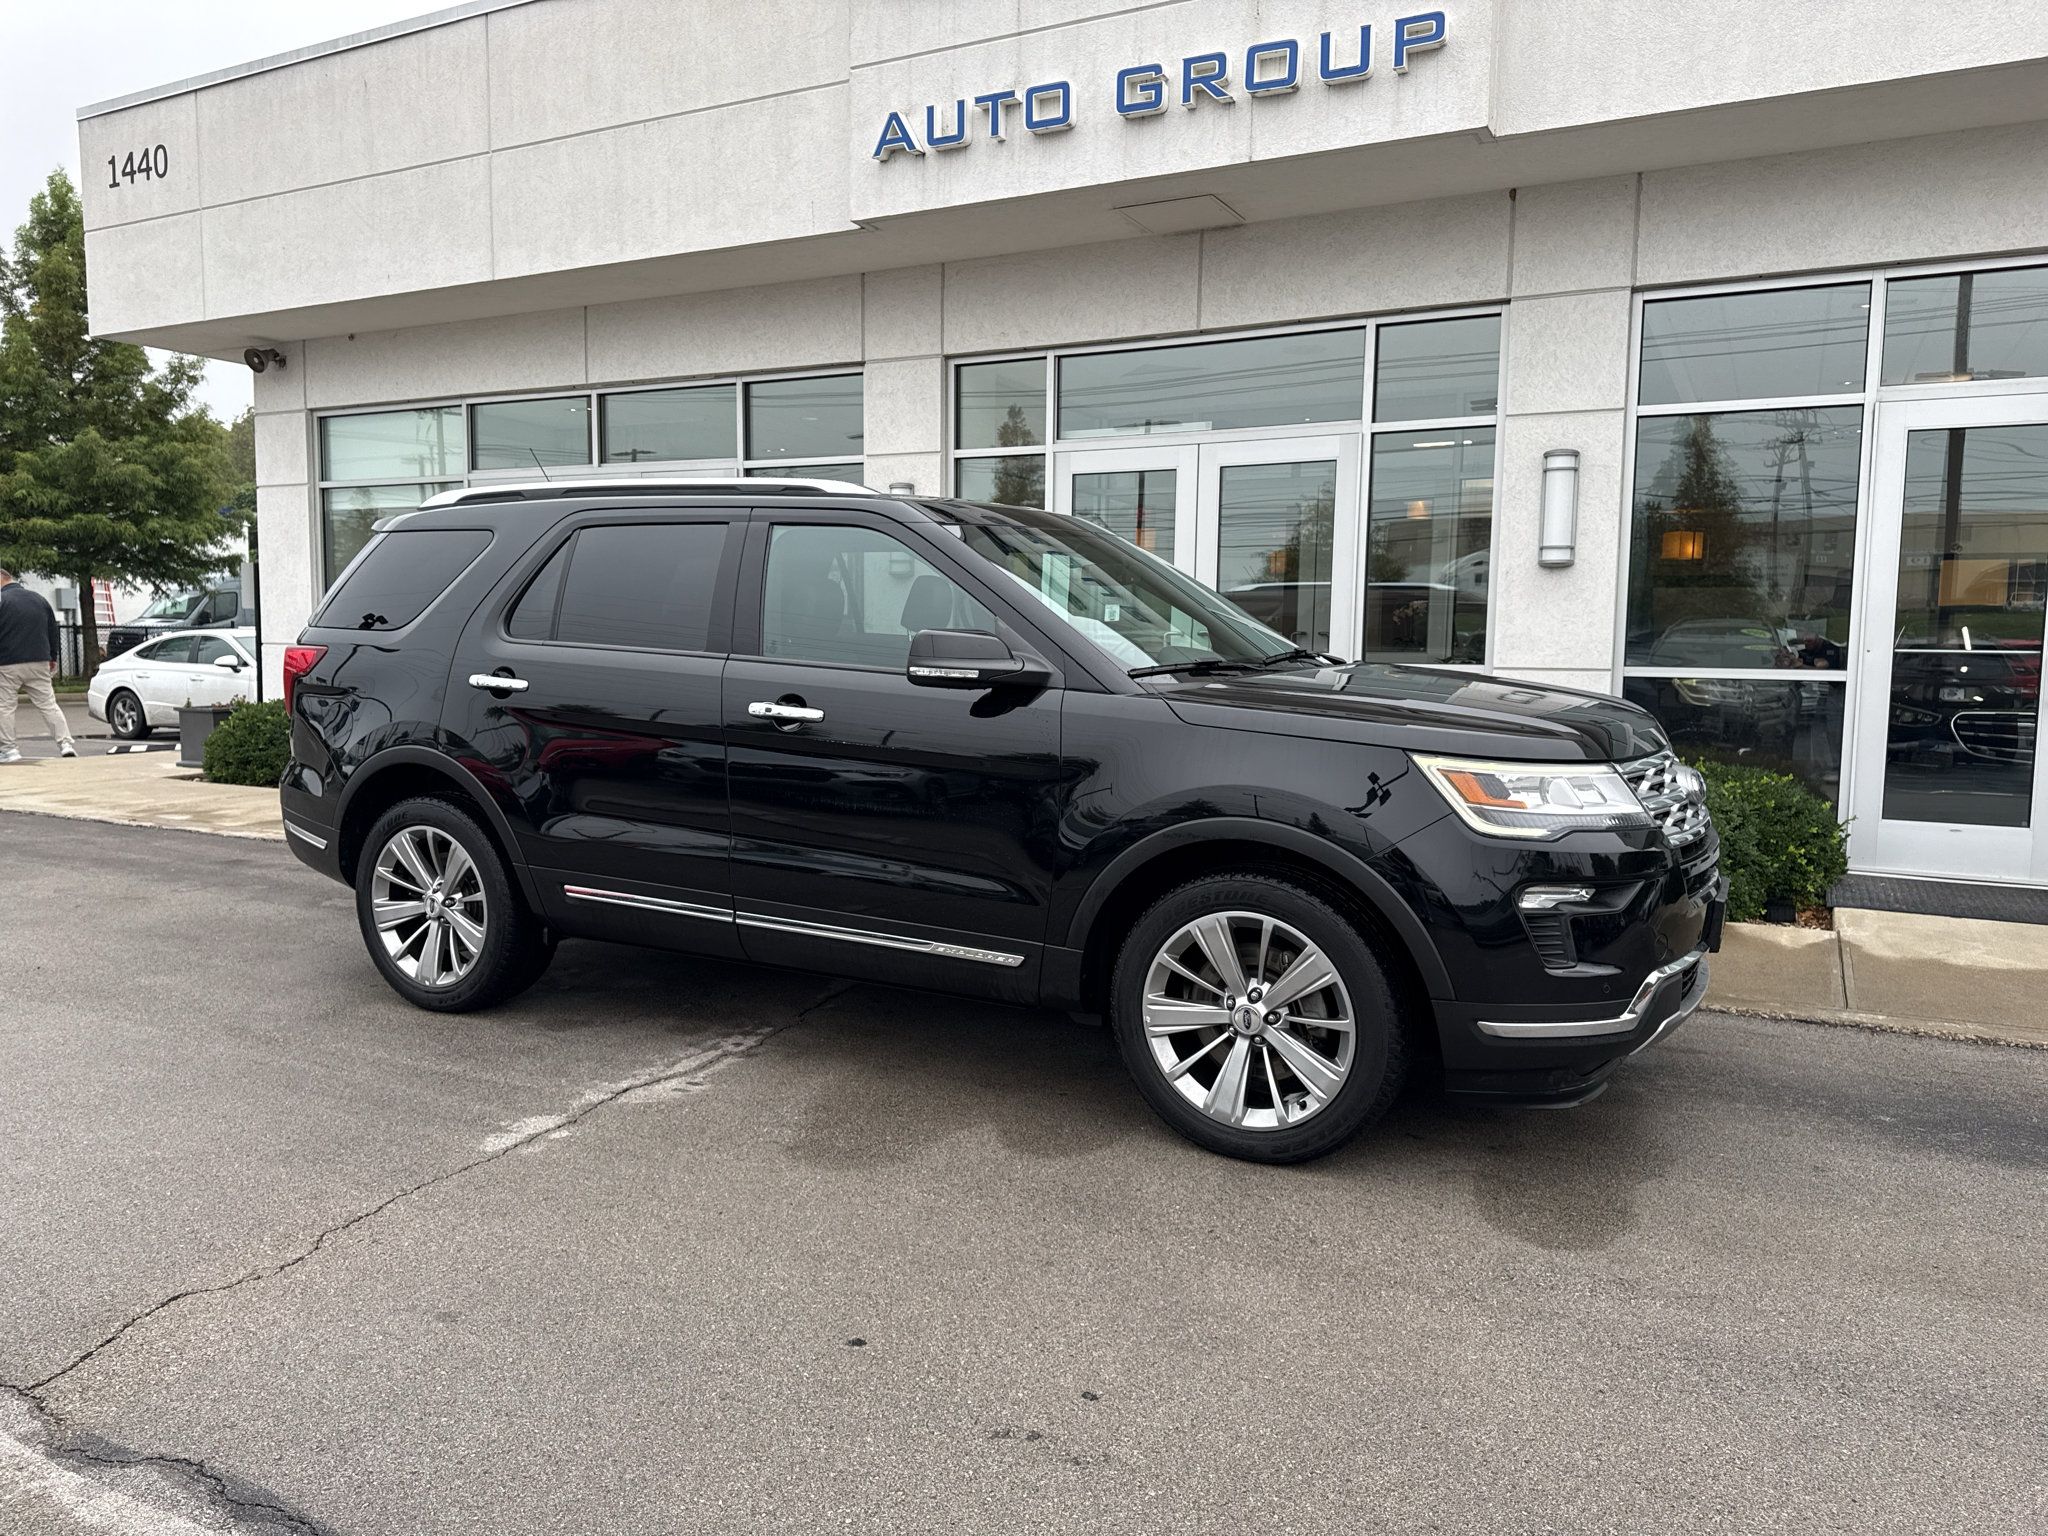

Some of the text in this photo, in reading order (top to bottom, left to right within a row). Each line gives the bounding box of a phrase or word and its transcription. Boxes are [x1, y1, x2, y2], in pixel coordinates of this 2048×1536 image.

[872, 10, 1447, 162] AUTO GROUP
[108, 144, 168, 188] 1440
